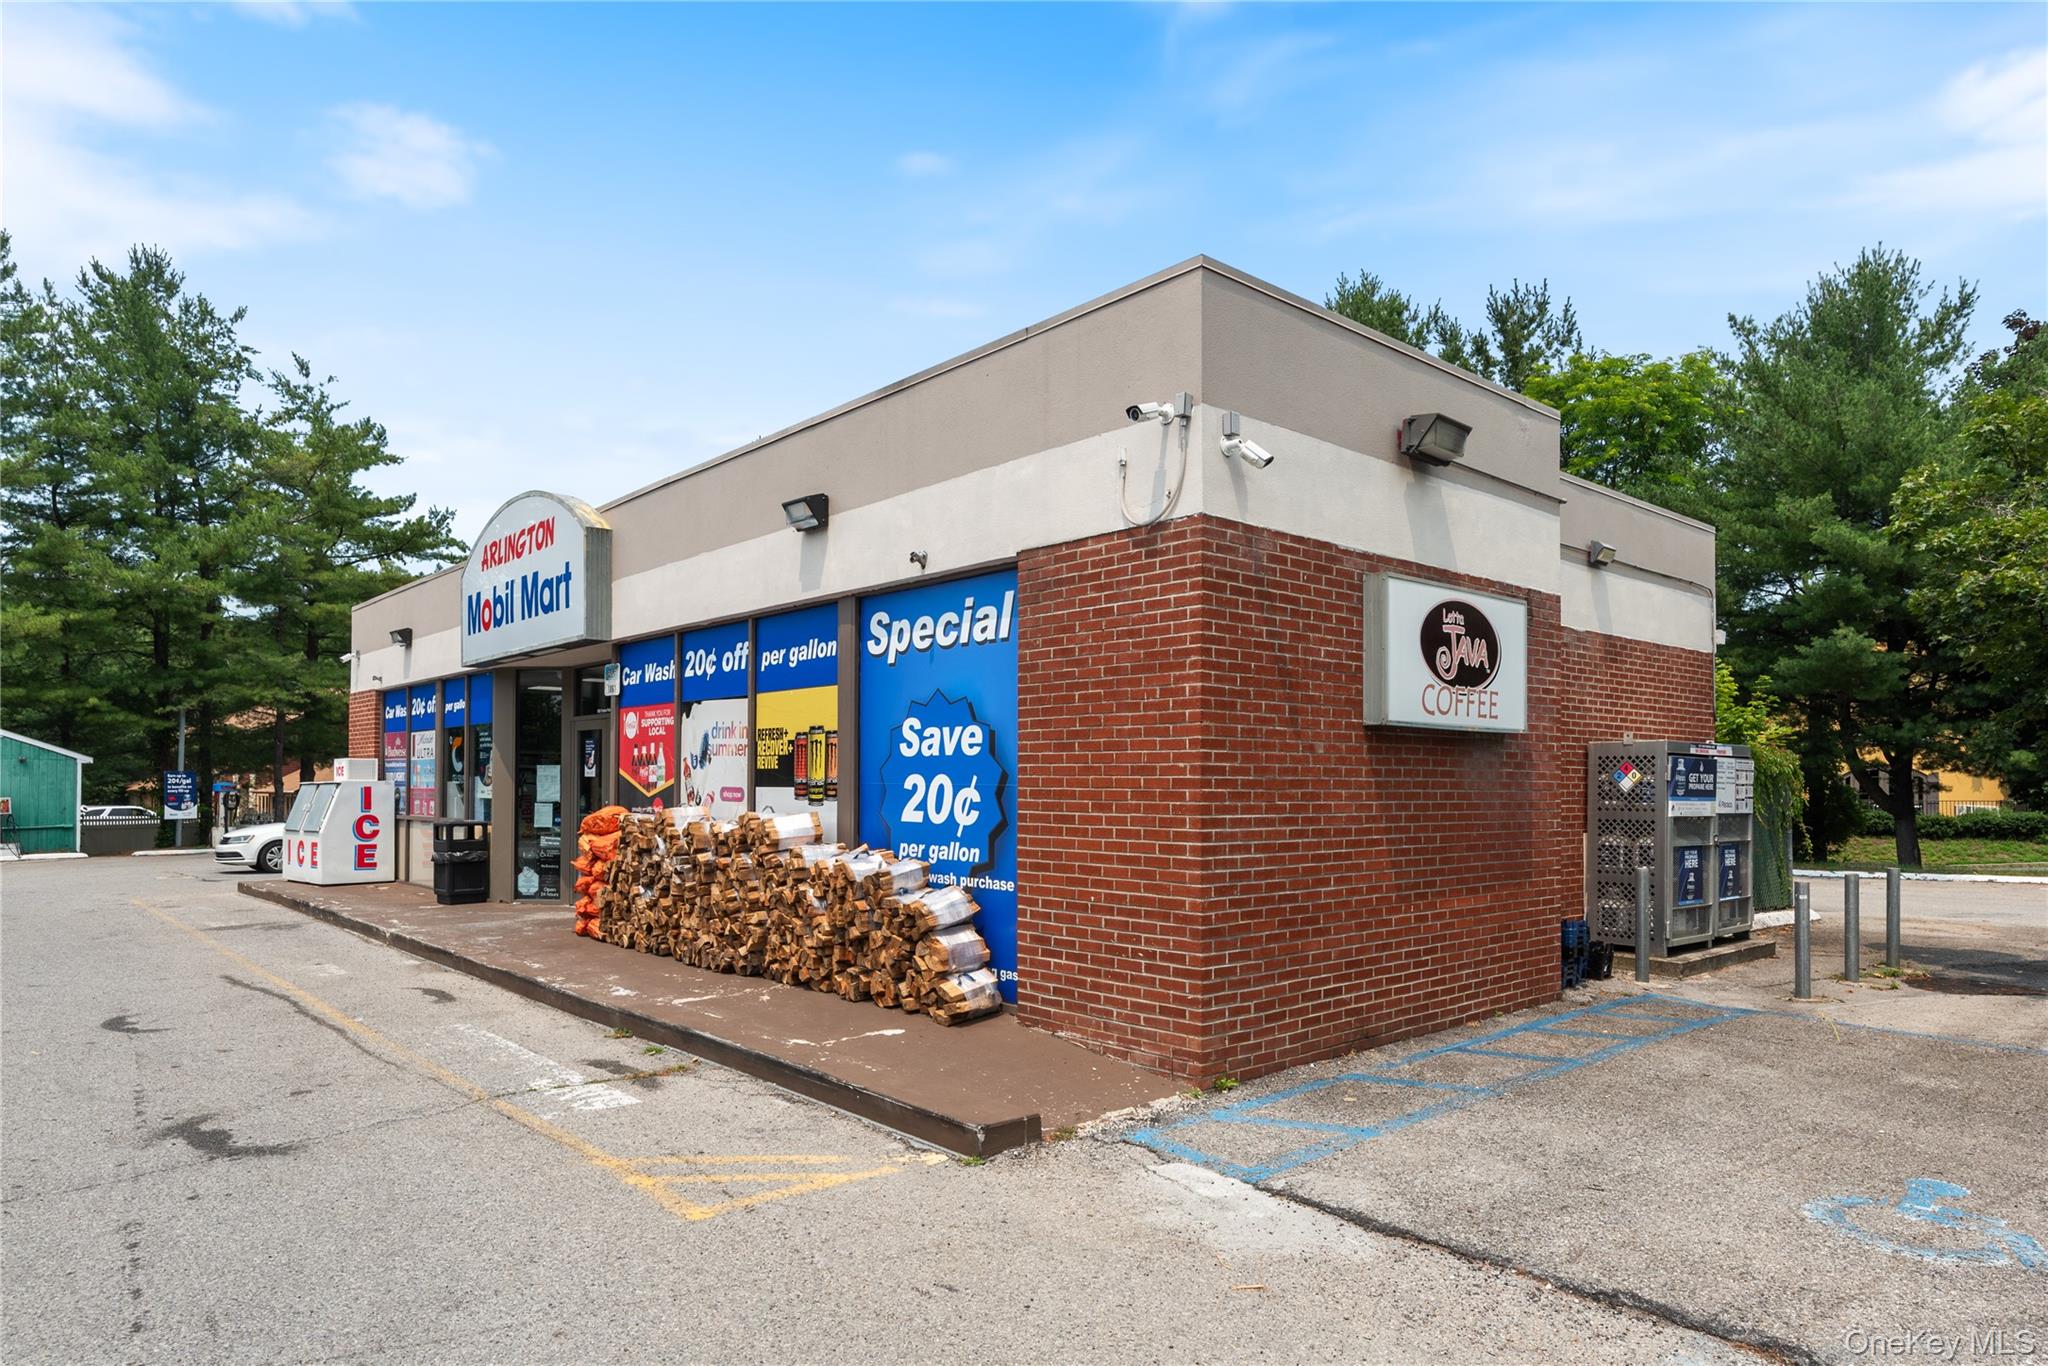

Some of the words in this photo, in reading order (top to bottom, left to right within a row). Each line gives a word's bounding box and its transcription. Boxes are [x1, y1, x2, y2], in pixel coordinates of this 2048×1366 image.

[482, 516, 555, 572] ARLINGTON
[467, 579, 515, 636] Mobil
[521, 561, 572, 620] Mart
[867, 590, 1015, 665] Special
[1443, 608, 1465, 625] Lotta
[685, 647, 717, 681] 20¢
[722, 641, 749, 672] off
[761, 649, 786, 672] per
[789, 637, 838, 668] gallon
[1435, 624, 1490, 681] JAVA
[622, 666, 642, 686] Car
[644, 658, 676, 683] Wash
[385, 706, 395, 719] Car
[395, 704, 407, 717] Was
[411, 697, 426, 718] 20¢
[445, 701, 455, 714] per
[454, 698, 466, 712] gallo
[1421, 683, 1499, 720] COFFEE
[641, 716, 675, 728] SUPPORTING
[648, 726, 667, 736] LOCAL
[711, 720, 737, 739] drink
[738, 720, 748, 739] in
[899, 717, 983, 757] Save
[707, 743, 748, 757] summer
[336, 766, 345, 777] ICE
[757, 756, 779, 769] REVIVE
[1688, 773, 1699, 783] GET
[1700, 773, 1714, 783] YOUR
[901, 773, 982, 838] 20¢
[352, 786, 380, 871] ICE
[287, 839, 318, 868] ICE
[899, 842, 926, 860] per
[928, 841, 981, 864] gallon
[928, 872, 957, 887] wash
[960, 876, 1015, 892] purchase
[1000, 968, 1018, 982] gas
